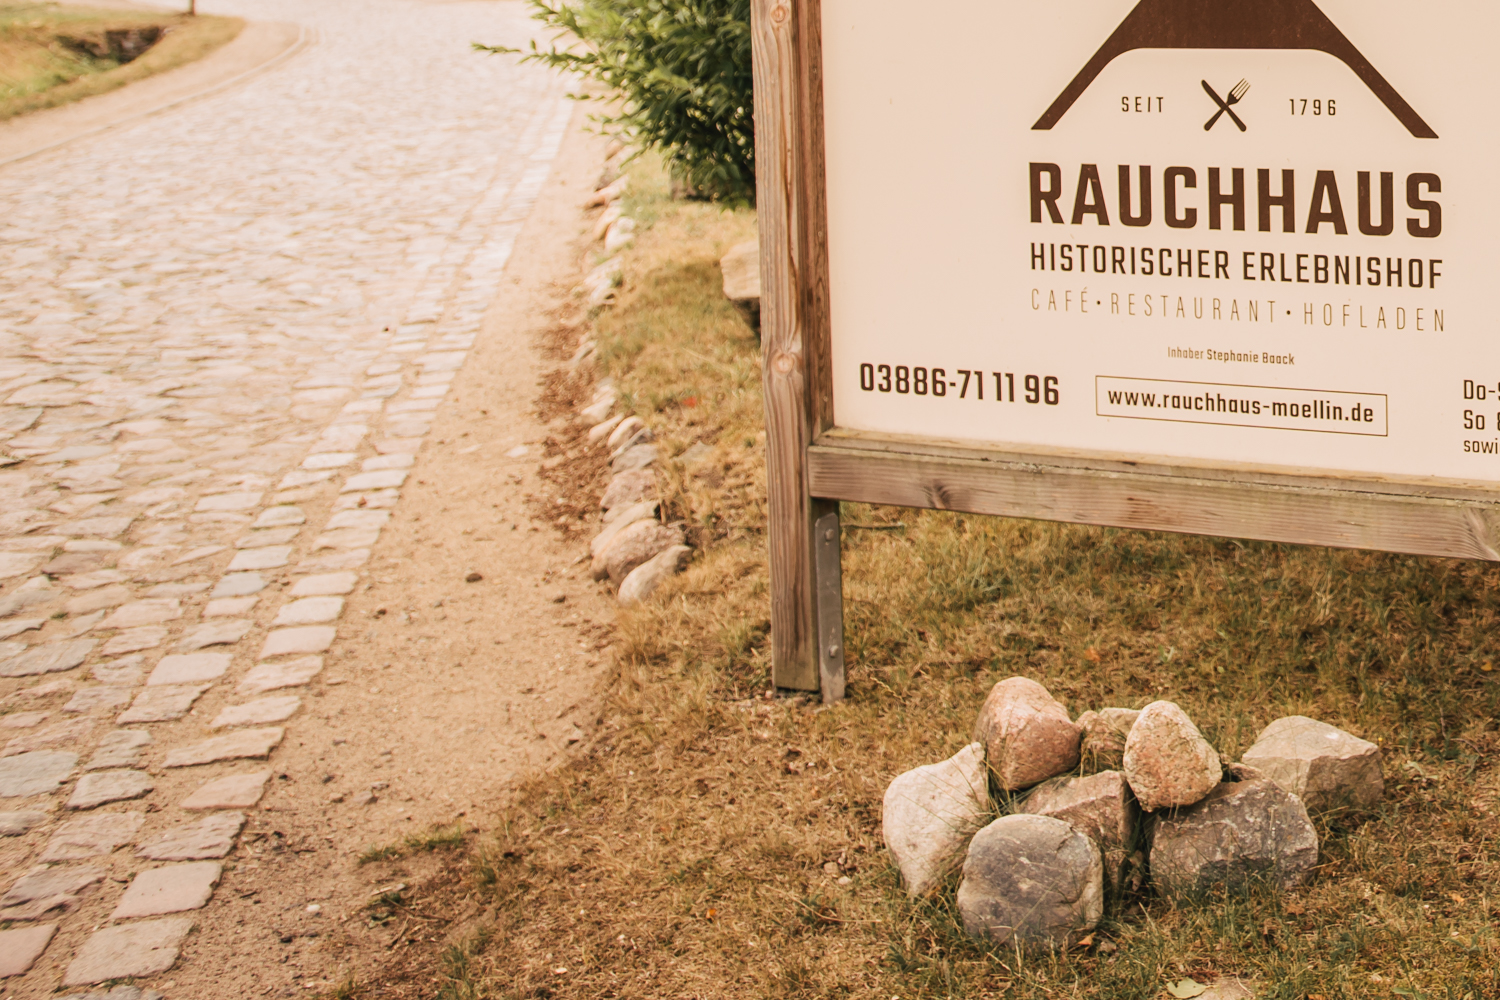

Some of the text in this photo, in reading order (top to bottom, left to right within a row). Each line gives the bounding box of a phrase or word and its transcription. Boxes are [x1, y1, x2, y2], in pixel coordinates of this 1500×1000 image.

[1121, 96, 1337, 116] SEIT 1796
[1029, 162, 1442, 238] RAUCHHAUS
[1030, 242, 1443, 289] HISTORISCHER ERLEBNISHOF
[1167, 346, 1295, 366] Inhaber Stephanie Baack
[860, 363, 1060, 406] 03886-71 11 96
[1107, 389, 1374, 423] www.rauchhaus-moellin.de
[1463, 409, 1486, 431] So
